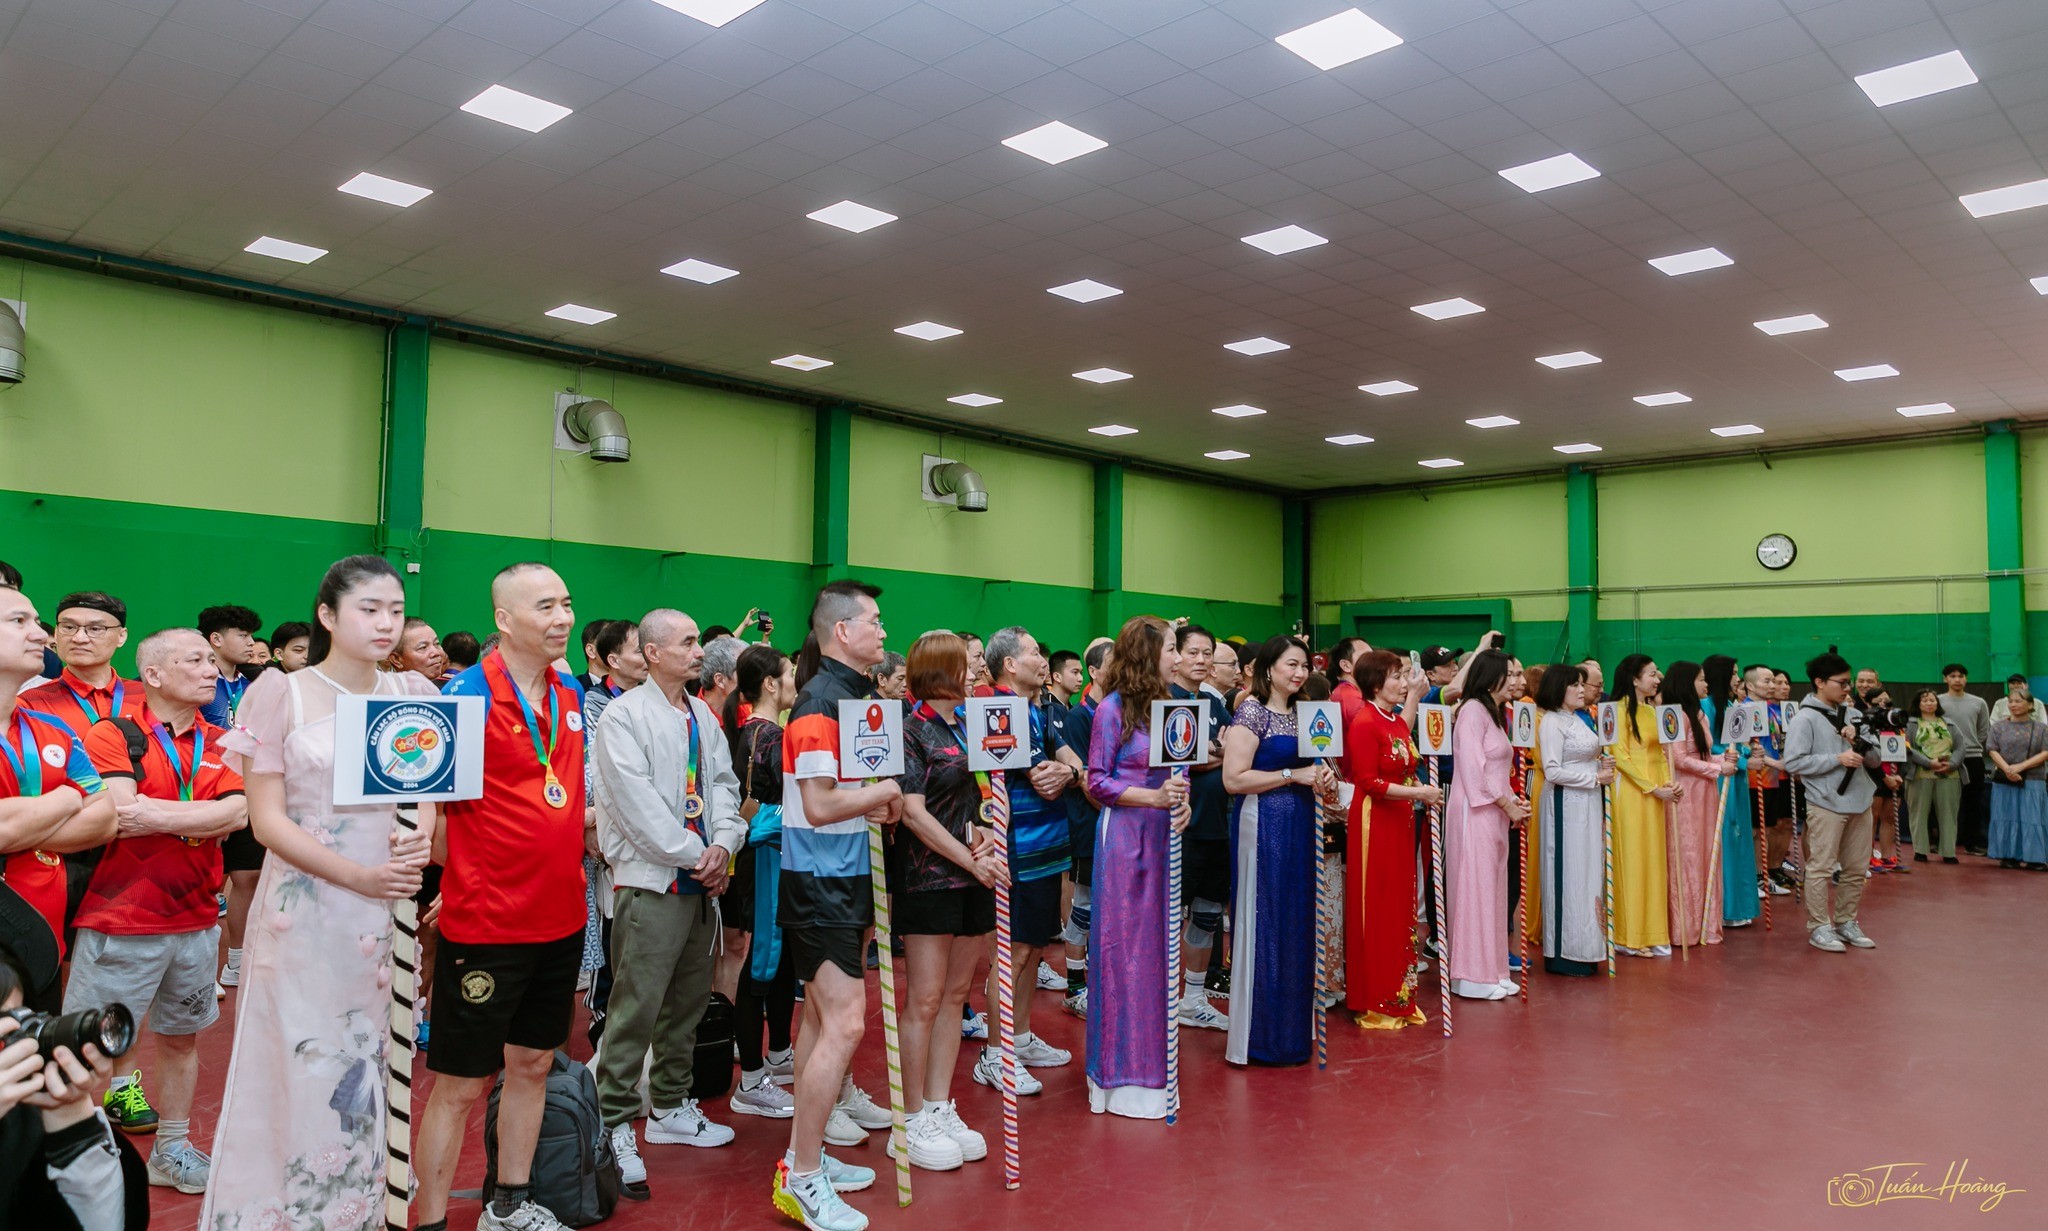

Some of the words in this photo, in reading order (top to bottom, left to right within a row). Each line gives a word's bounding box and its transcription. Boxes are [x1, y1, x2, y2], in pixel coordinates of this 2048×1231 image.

[397, 706, 418, 716] BÓNG
[418, 708, 433, 718] BÀN
[432, 713, 445, 728] VIỆT
[442, 726, 452, 743] NAM
[1030, 748, 1041, 758] OLA
[199, 759, 223, 769] ONIC
